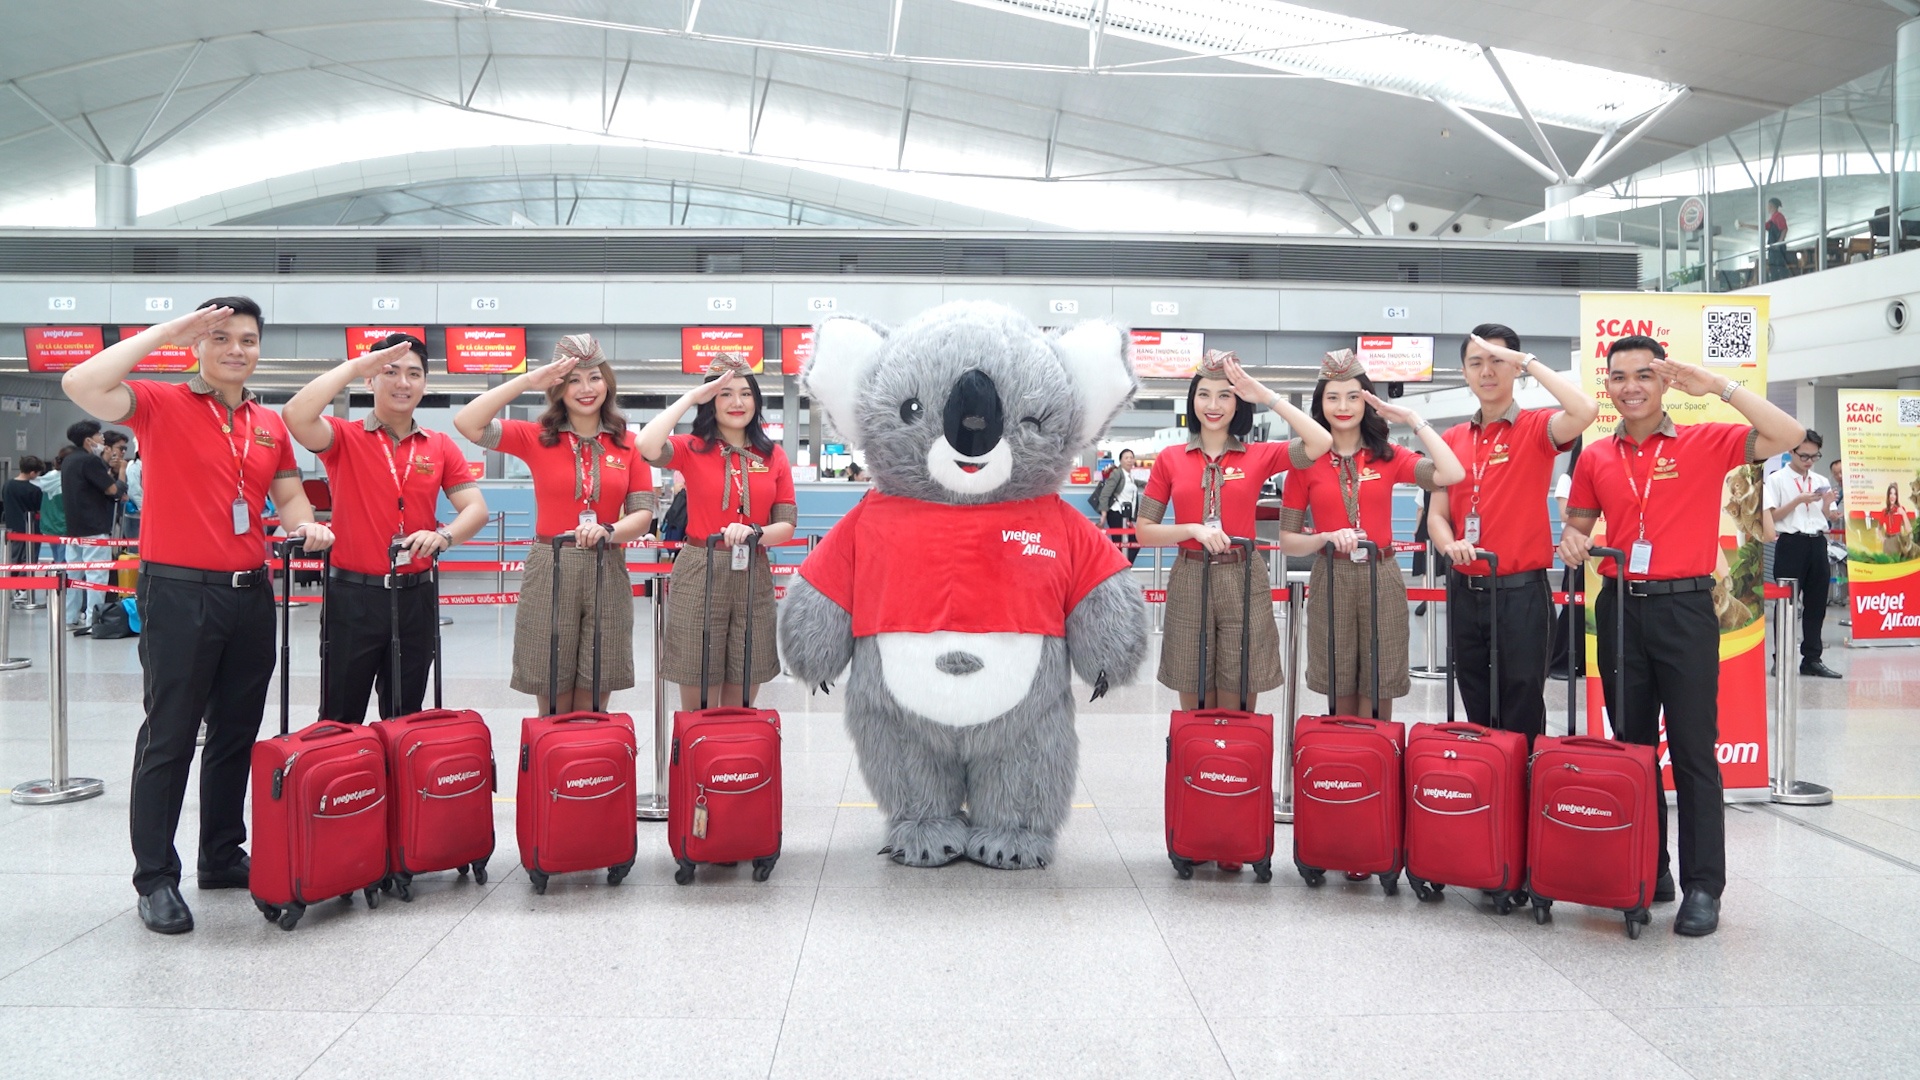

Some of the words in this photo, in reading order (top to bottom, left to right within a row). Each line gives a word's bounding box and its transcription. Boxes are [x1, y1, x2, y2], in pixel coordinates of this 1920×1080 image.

[53, 298, 73, 308] G-9
[151, 299, 170, 309] G-8
[476, 299, 496, 309] G-6
[713, 300, 733, 310] G-5
[813, 300, 833, 310] G-4
[1055, 302, 1075, 312] G-3
[1156, 303, 1176, 313] G-2
[1387, 308, 1406, 318] G-1
[1596, 319, 1653, 337] SCAN
[1656, 327, 1670, 337] for
[1596, 367, 1610, 375] STE
[1596, 391, 1611, 399] STE
[1846, 403, 1874, 412] SCAN
[1846, 413, 1882, 424] MAGIC
[59, 537, 79, 545] TIA
[42, 562, 87, 570] INTERNATIONAL
[500, 562, 525, 571] TIA
[1564, 594, 1583, 603] CNG
